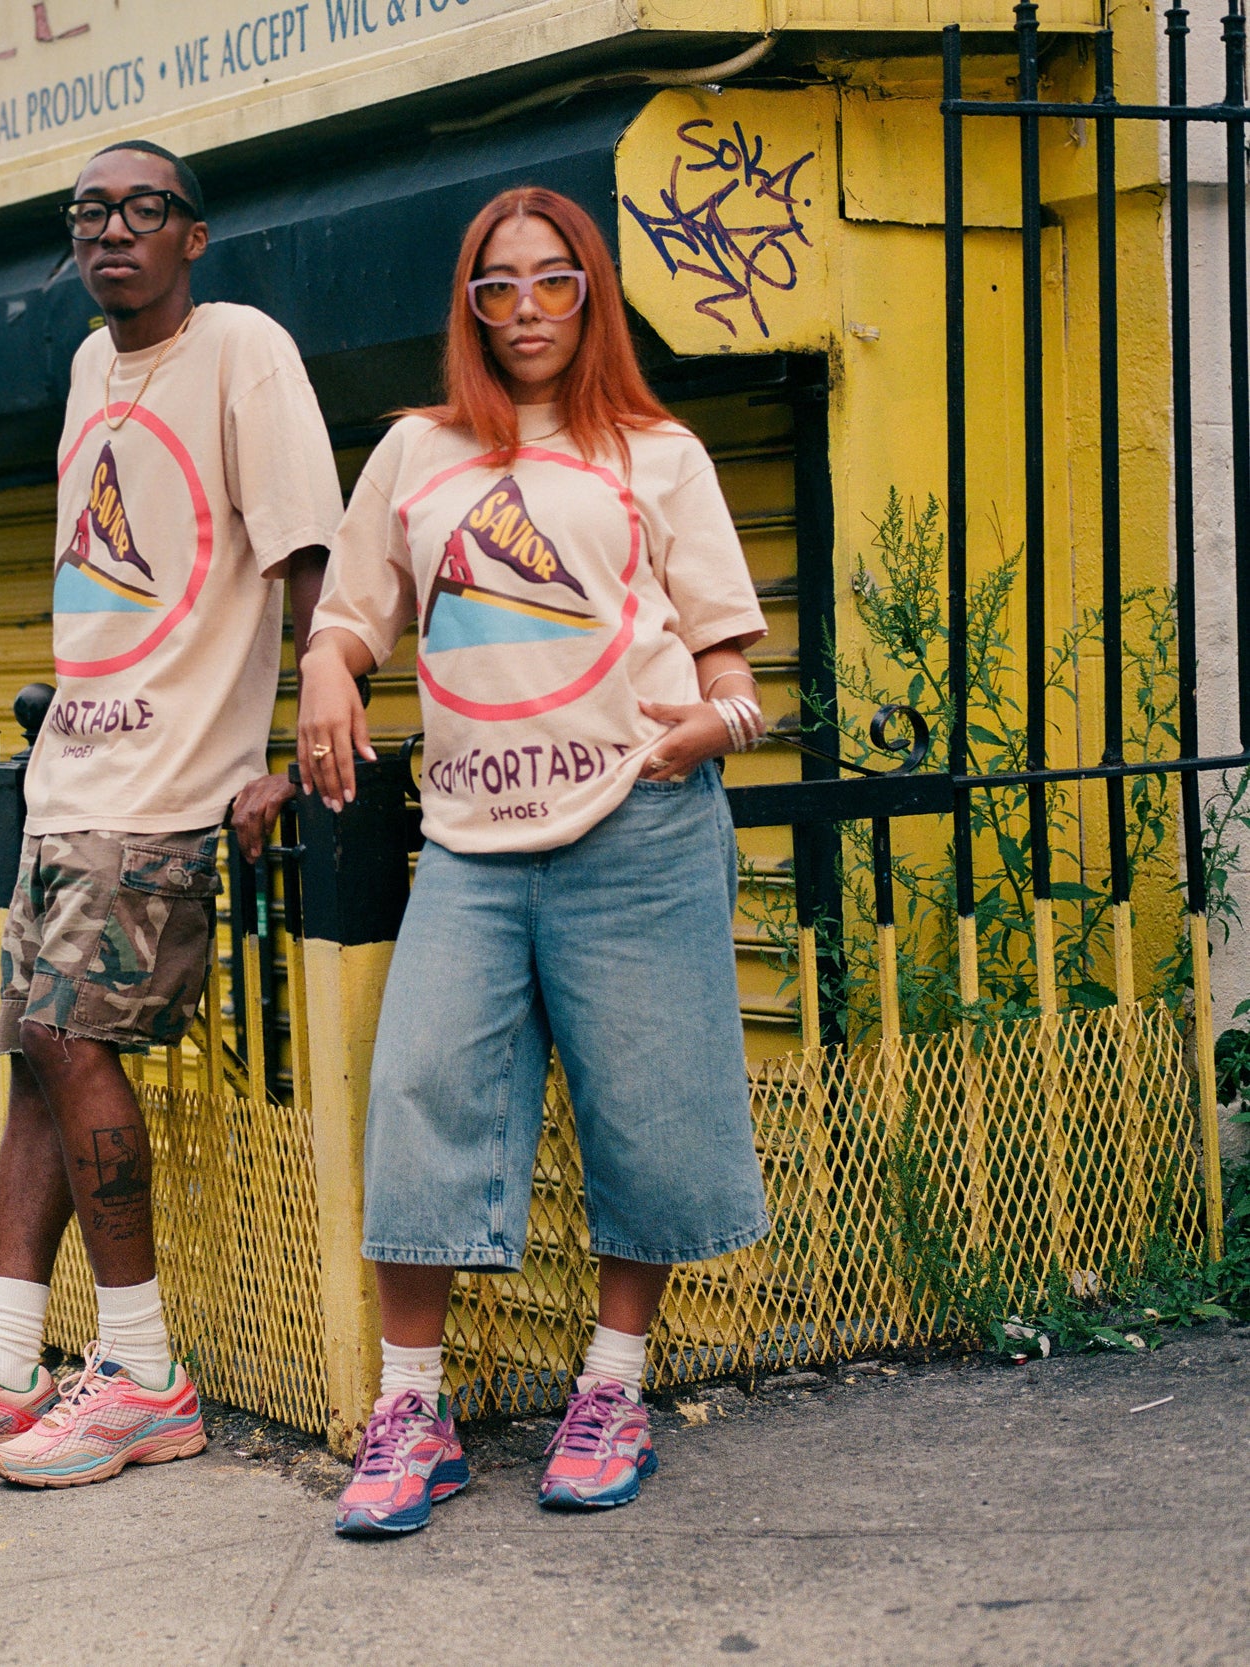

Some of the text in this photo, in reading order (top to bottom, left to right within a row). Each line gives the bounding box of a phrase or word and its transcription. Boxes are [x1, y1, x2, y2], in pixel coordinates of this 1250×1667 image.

[27, 56, 145, 135] PRODUCTS
[175, 35, 210, 89] WE
[219, 3, 310, 78] ACCEPT
[325, 0, 379, 43] WIC
[90, 462, 130, 560] SAVIOR
[469, 490, 558, 582] SAVIOR
[61, 744, 95, 759] SHOES
[489, 801, 550, 822] SHOES
